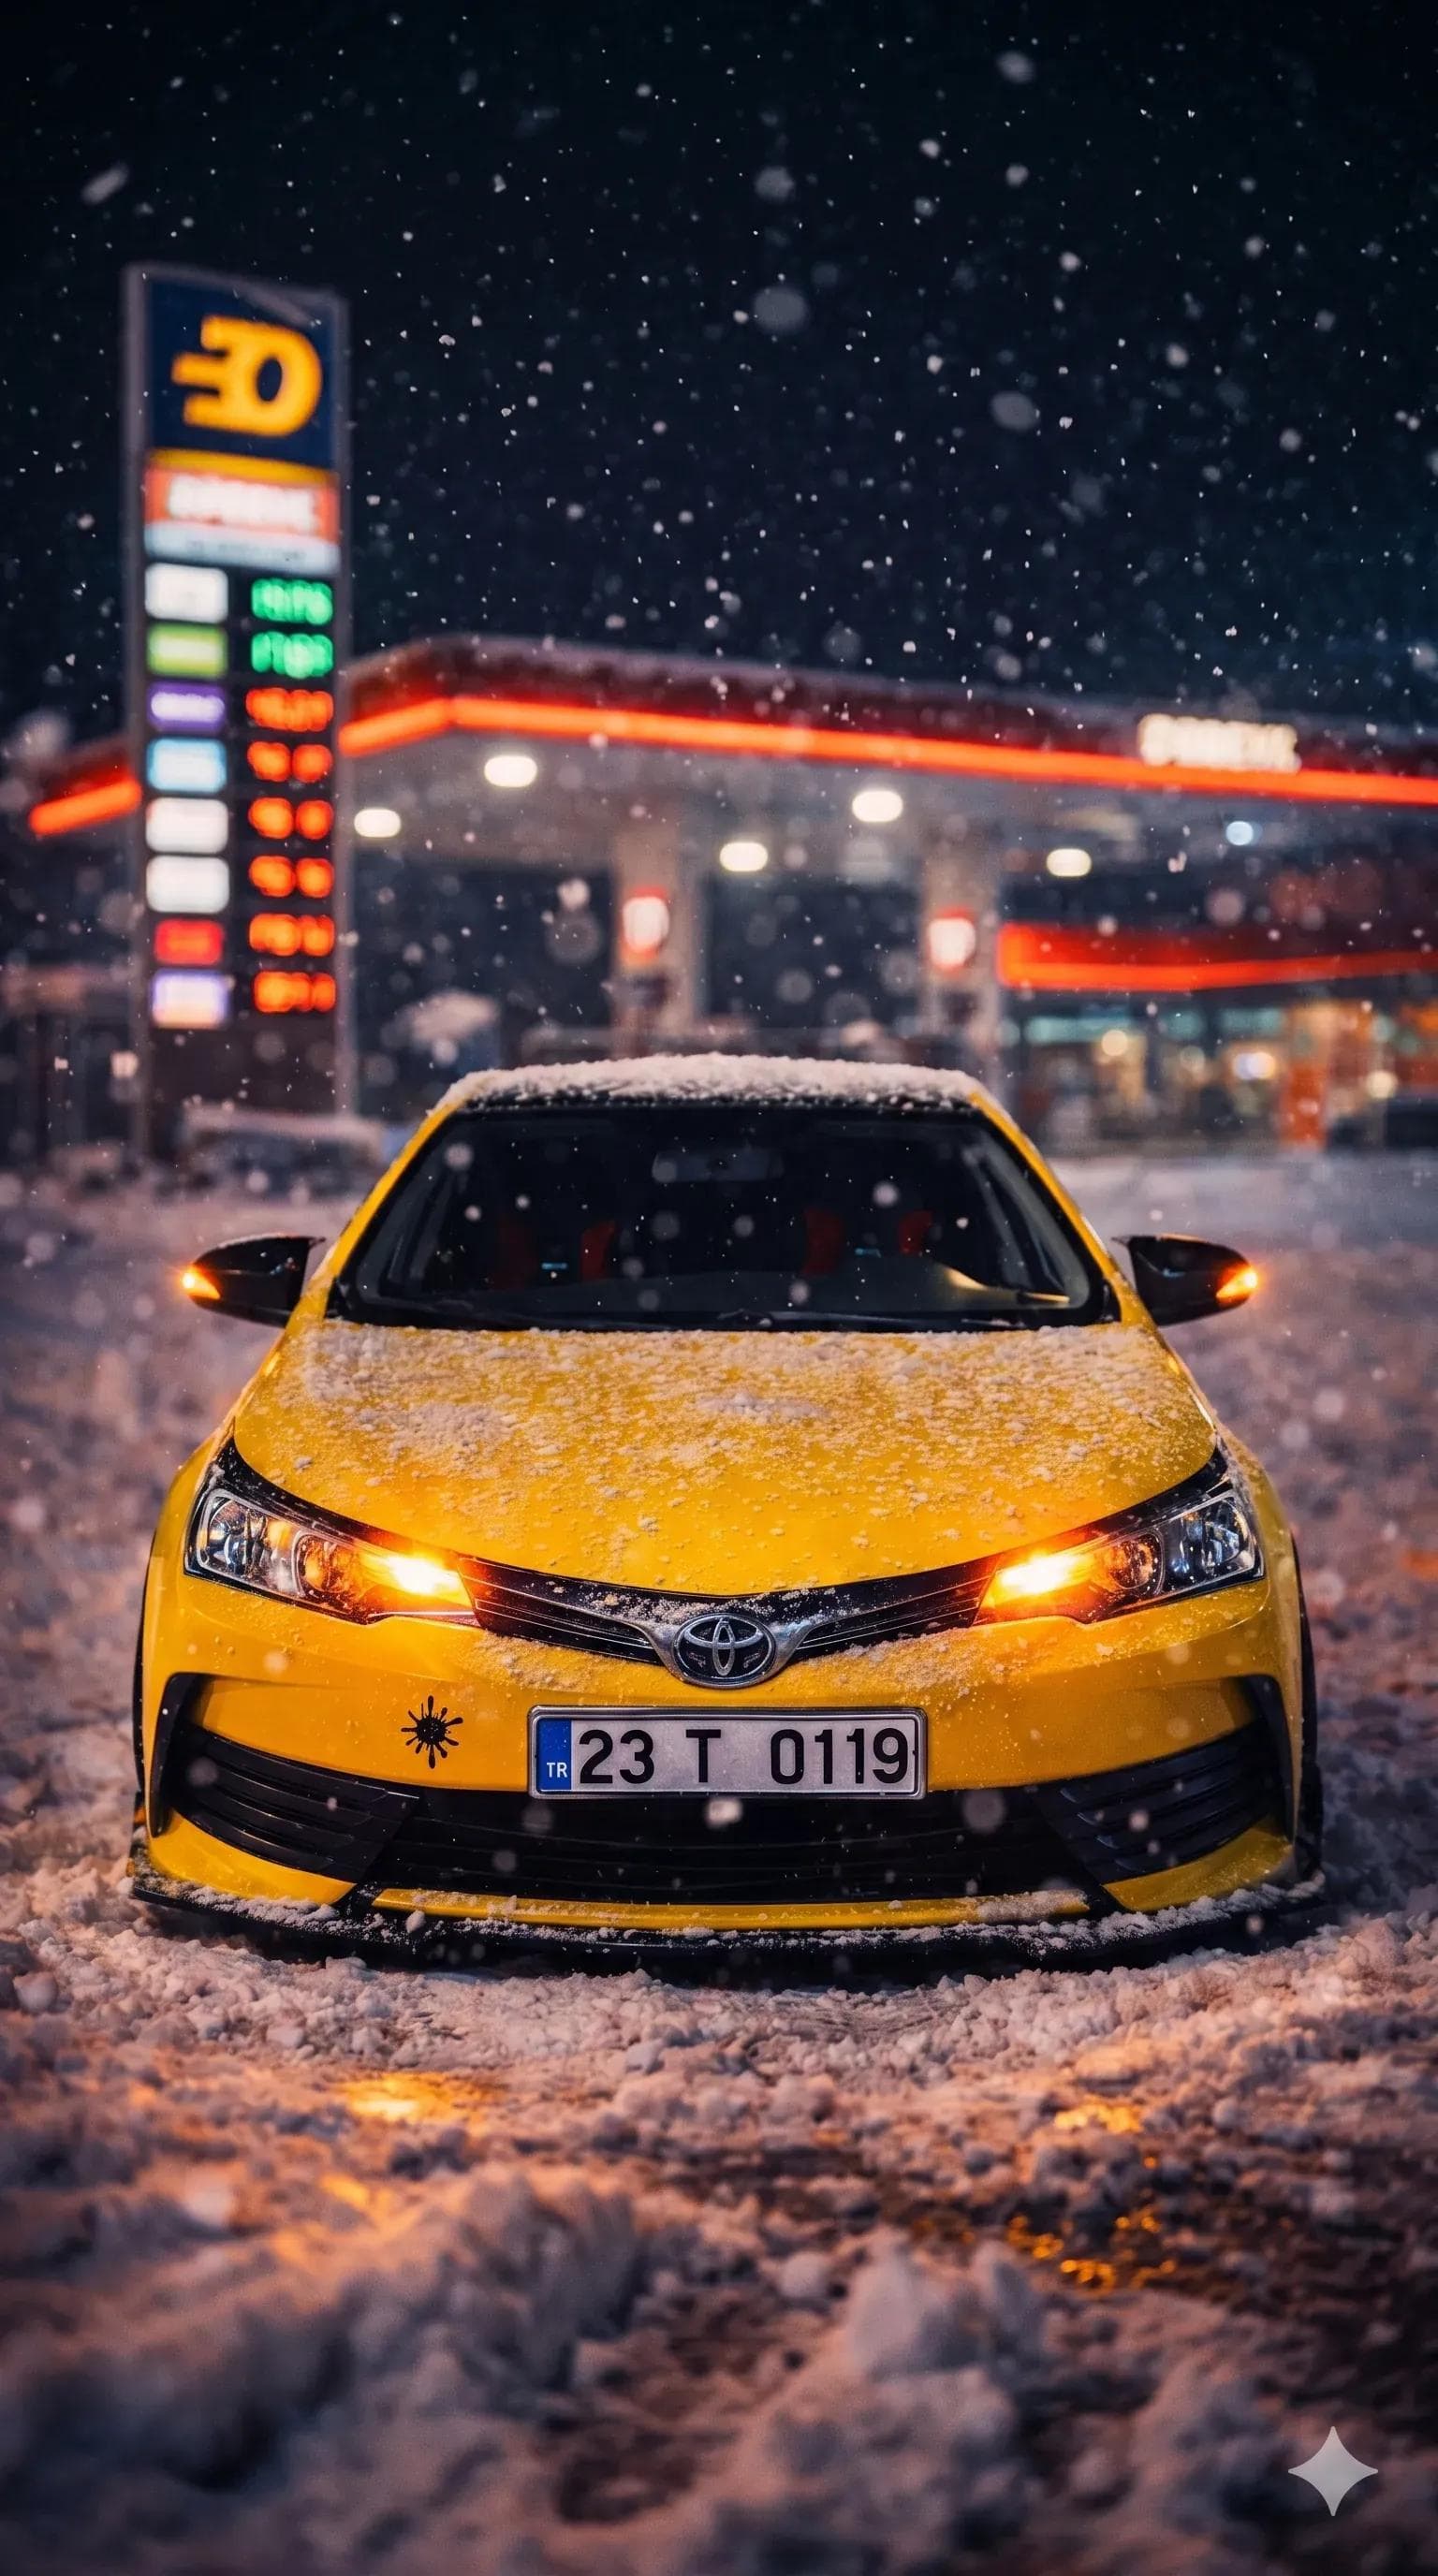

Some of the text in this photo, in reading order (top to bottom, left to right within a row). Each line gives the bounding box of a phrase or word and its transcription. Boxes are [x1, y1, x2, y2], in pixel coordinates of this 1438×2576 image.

[546, 1762, 568, 1778] TR
[579, 1728, 908, 1784] 23 T 0119
